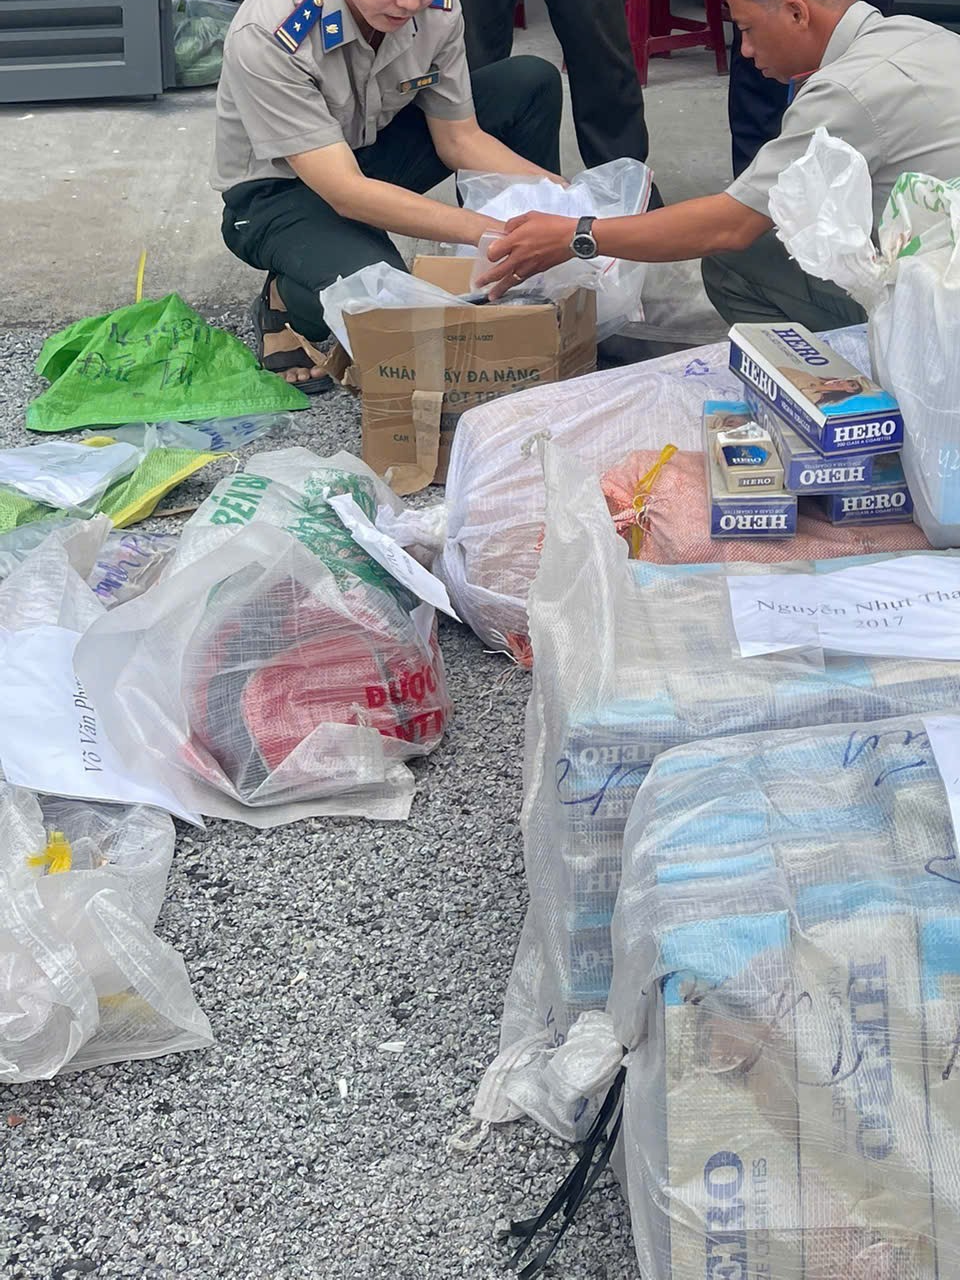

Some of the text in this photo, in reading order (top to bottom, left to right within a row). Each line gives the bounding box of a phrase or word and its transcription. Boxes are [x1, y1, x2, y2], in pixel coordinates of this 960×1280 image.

[772, 328, 829, 366] HERO
[467, 370, 489, 383] ĐA
[494, 366, 541, 383] NĂNG
[740, 352, 777, 402] HERO
[833, 421, 896, 443] HERO
[742, 477, 771, 485] HERO
[800, 466, 865, 485] HERO
[841, 491, 906, 513] HERO
[720, 513, 788, 531] HERO
[756, 599, 846, 616] Nguyễn
[856, 616, 905, 629] 2017
[78, 715, 97, 745] Văn
[704, 1150, 749, 1280] ERO
